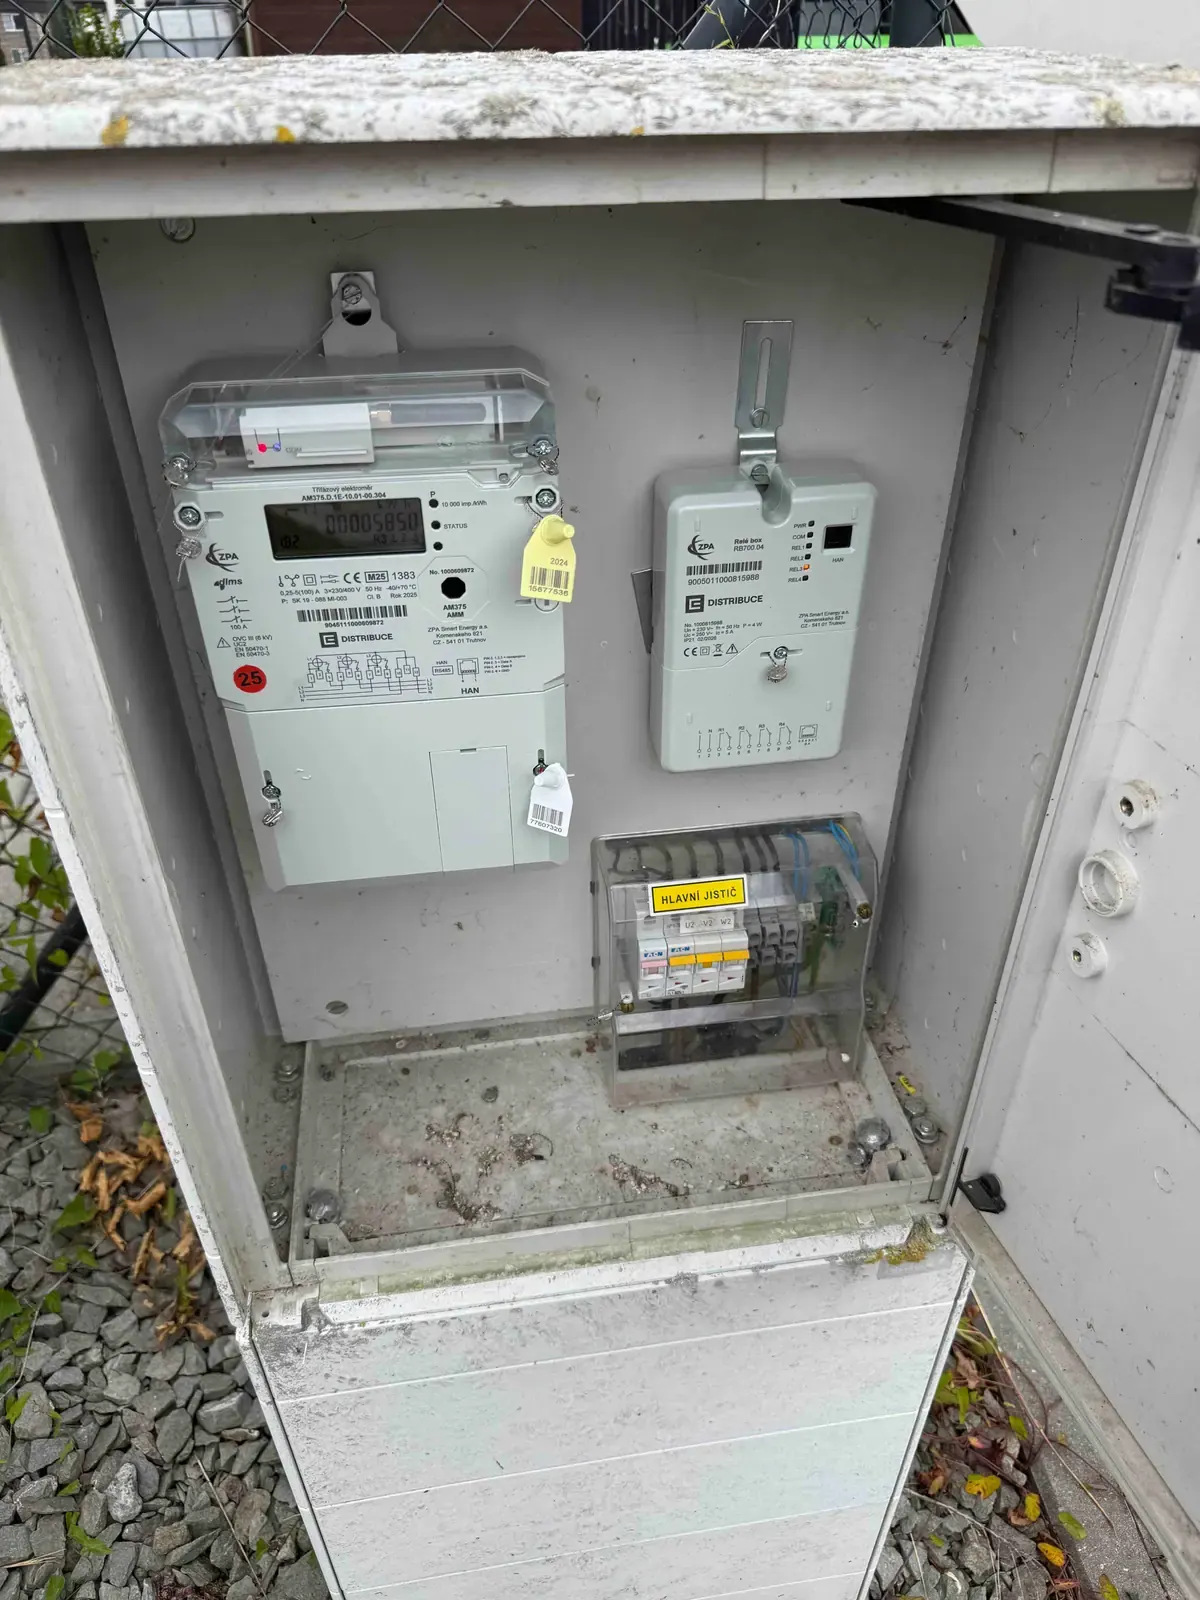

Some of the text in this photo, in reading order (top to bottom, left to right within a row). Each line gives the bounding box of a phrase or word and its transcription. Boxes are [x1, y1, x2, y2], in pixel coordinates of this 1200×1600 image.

[302, 492, 386, 501] AM375.D.1E-10.01-00.304
[326, 513, 418, 534] 00005850
[550, 558, 568, 566] 2024
[392, 571, 415, 580] 1383
[688, 574, 759, 585] 9005011000815988
[219, 578, 242, 586] dlms
[529, 585, 568, 596] 15677536
[708, 595, 763, 606] DISTRIBUCE
[341, 634, 393, 642] DISTRIBUCE
[238, 671, 263, 687] 25
[530, 819, 562, 832] 77607320
[662, 887, 737, 904] HLAVNÍ JISTIČ
